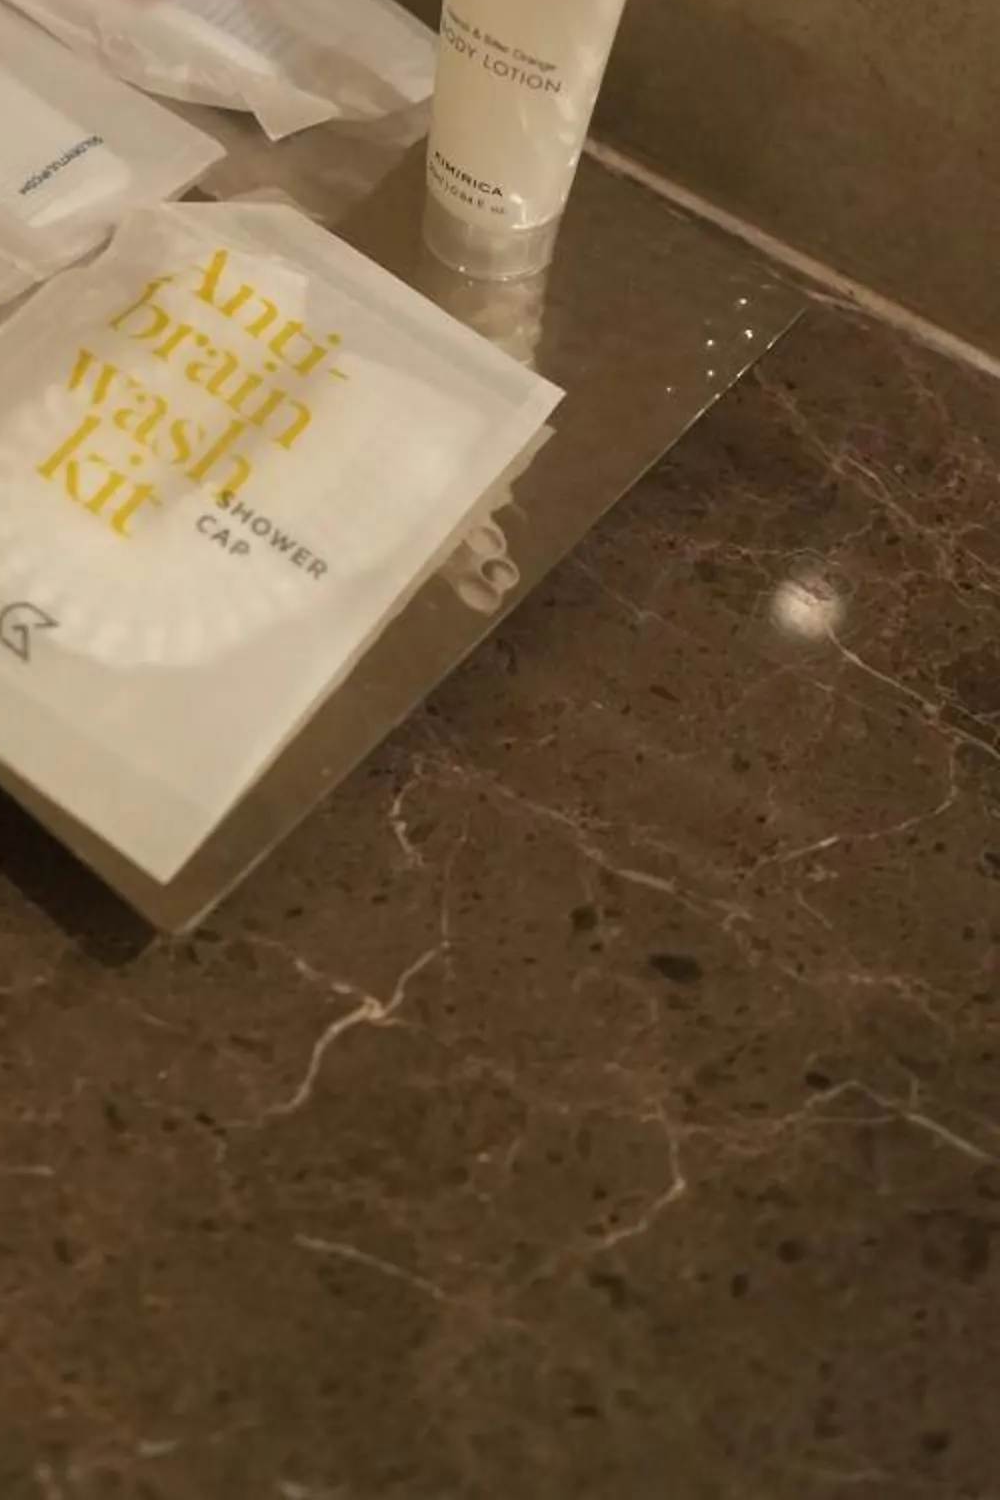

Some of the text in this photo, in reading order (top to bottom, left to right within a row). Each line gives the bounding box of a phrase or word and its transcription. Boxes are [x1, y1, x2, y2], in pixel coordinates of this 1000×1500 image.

[482, 54, 563, 93] LOTION
[107, 274, 312, 449] brain
[192, 248, 349, 380] Anti-
[35, 413, 166, 539] kit
[66, 346, 253, 502] wash
[195, 513, 251, 558] CAP
[214, 489, 329, 580] SHOWER
